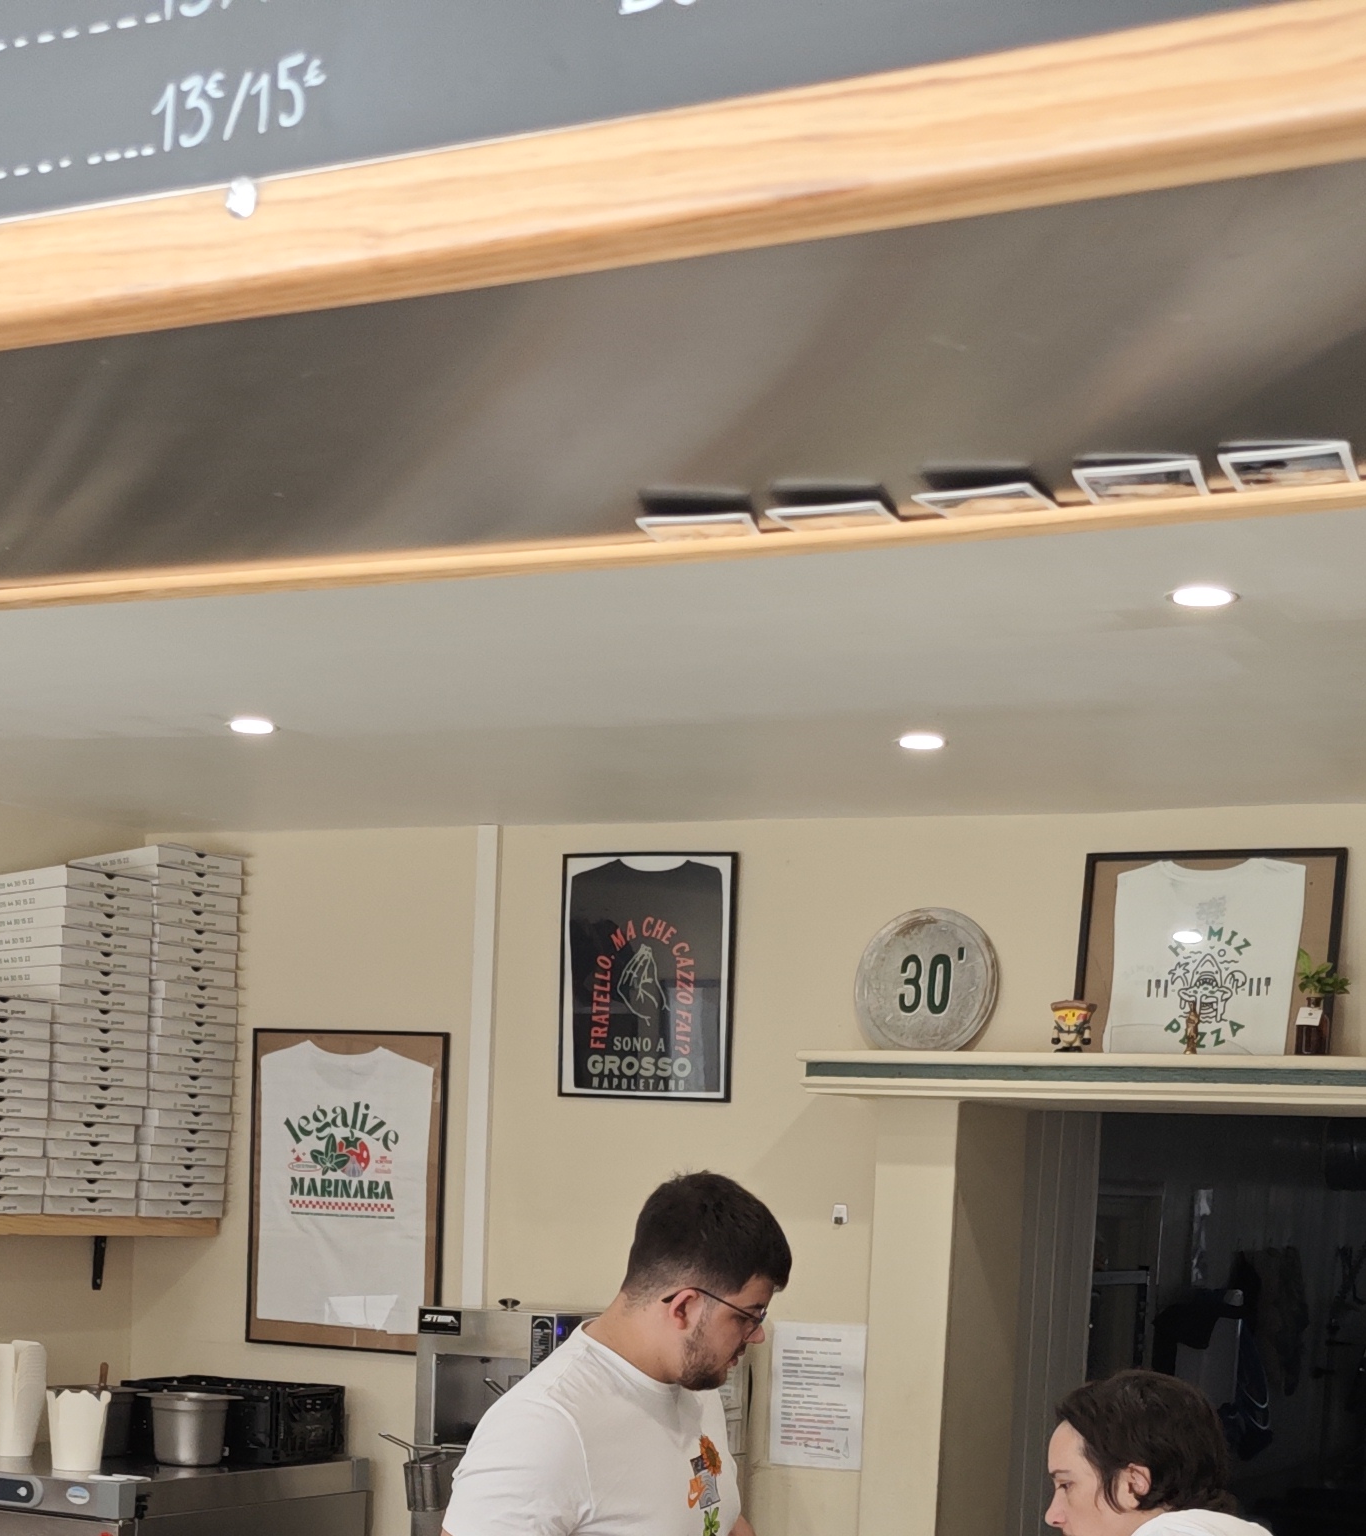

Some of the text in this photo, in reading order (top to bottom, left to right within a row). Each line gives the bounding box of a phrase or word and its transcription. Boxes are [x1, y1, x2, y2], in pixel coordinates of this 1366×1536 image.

[610, 920, 636, 951] MA
[642, 916, 677, 944] CHE
[1168, 925, 1251, 957] HMIZ
[672, 942, 695, 1005] CAZZO
[613, 1036, 666, 1052] SONO A
[675, 1009, 692, 1056] FAI?
[587, 1054, 692, 1078] GROSSO
[592, 1077, 685, 1091] NAPOLETANO
[283, 1101, 399, 1152] legalize
[290, 1176, 394, 1200] MARINARA
